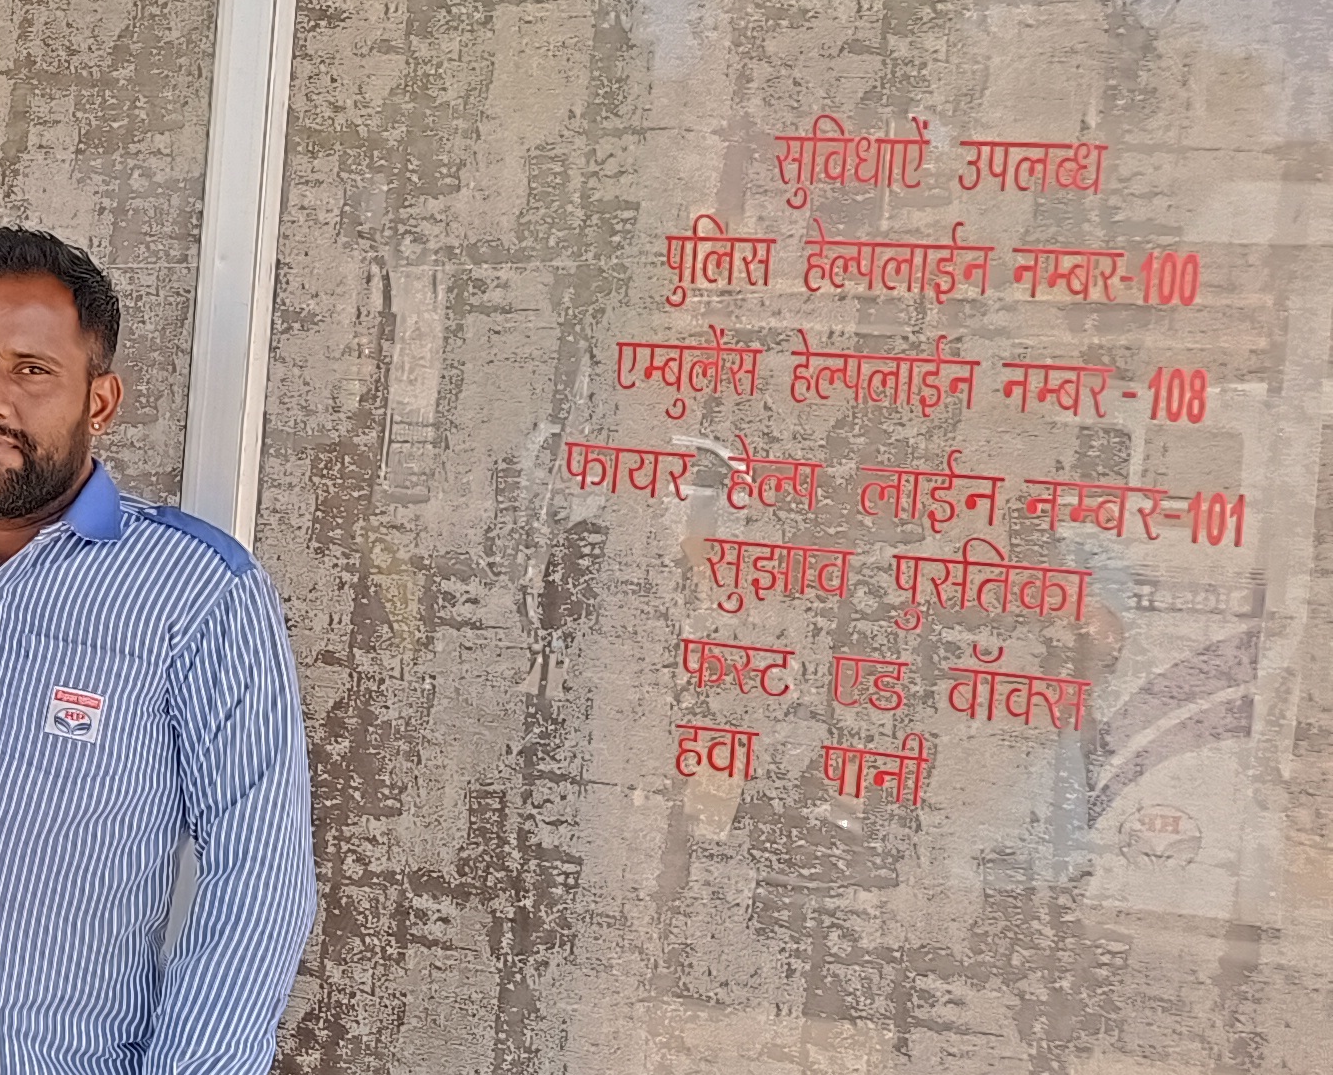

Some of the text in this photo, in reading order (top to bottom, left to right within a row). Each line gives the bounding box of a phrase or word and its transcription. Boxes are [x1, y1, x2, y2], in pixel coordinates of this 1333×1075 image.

[958, 140, 1109, 195] उपलब्ध
[665, 214, 777, 308] पुलिस
[804, 217, 995, 305] हेल्पलाईन
[616, 324, 764, 420] एम्बुलेंस
[790, 328, 981, 418] हेल्पलाईन
[564, 441, 697, 501] फायर
[726, 434, 824, 510] हेल्प
[860, 449, 1005, 534] लाईन
[704, 538, 855, 614] सुझाव
[681, 639, 1091, 731] फस्ट एड बॉक्स
[675, 724, 930, 807] हवा पानी
